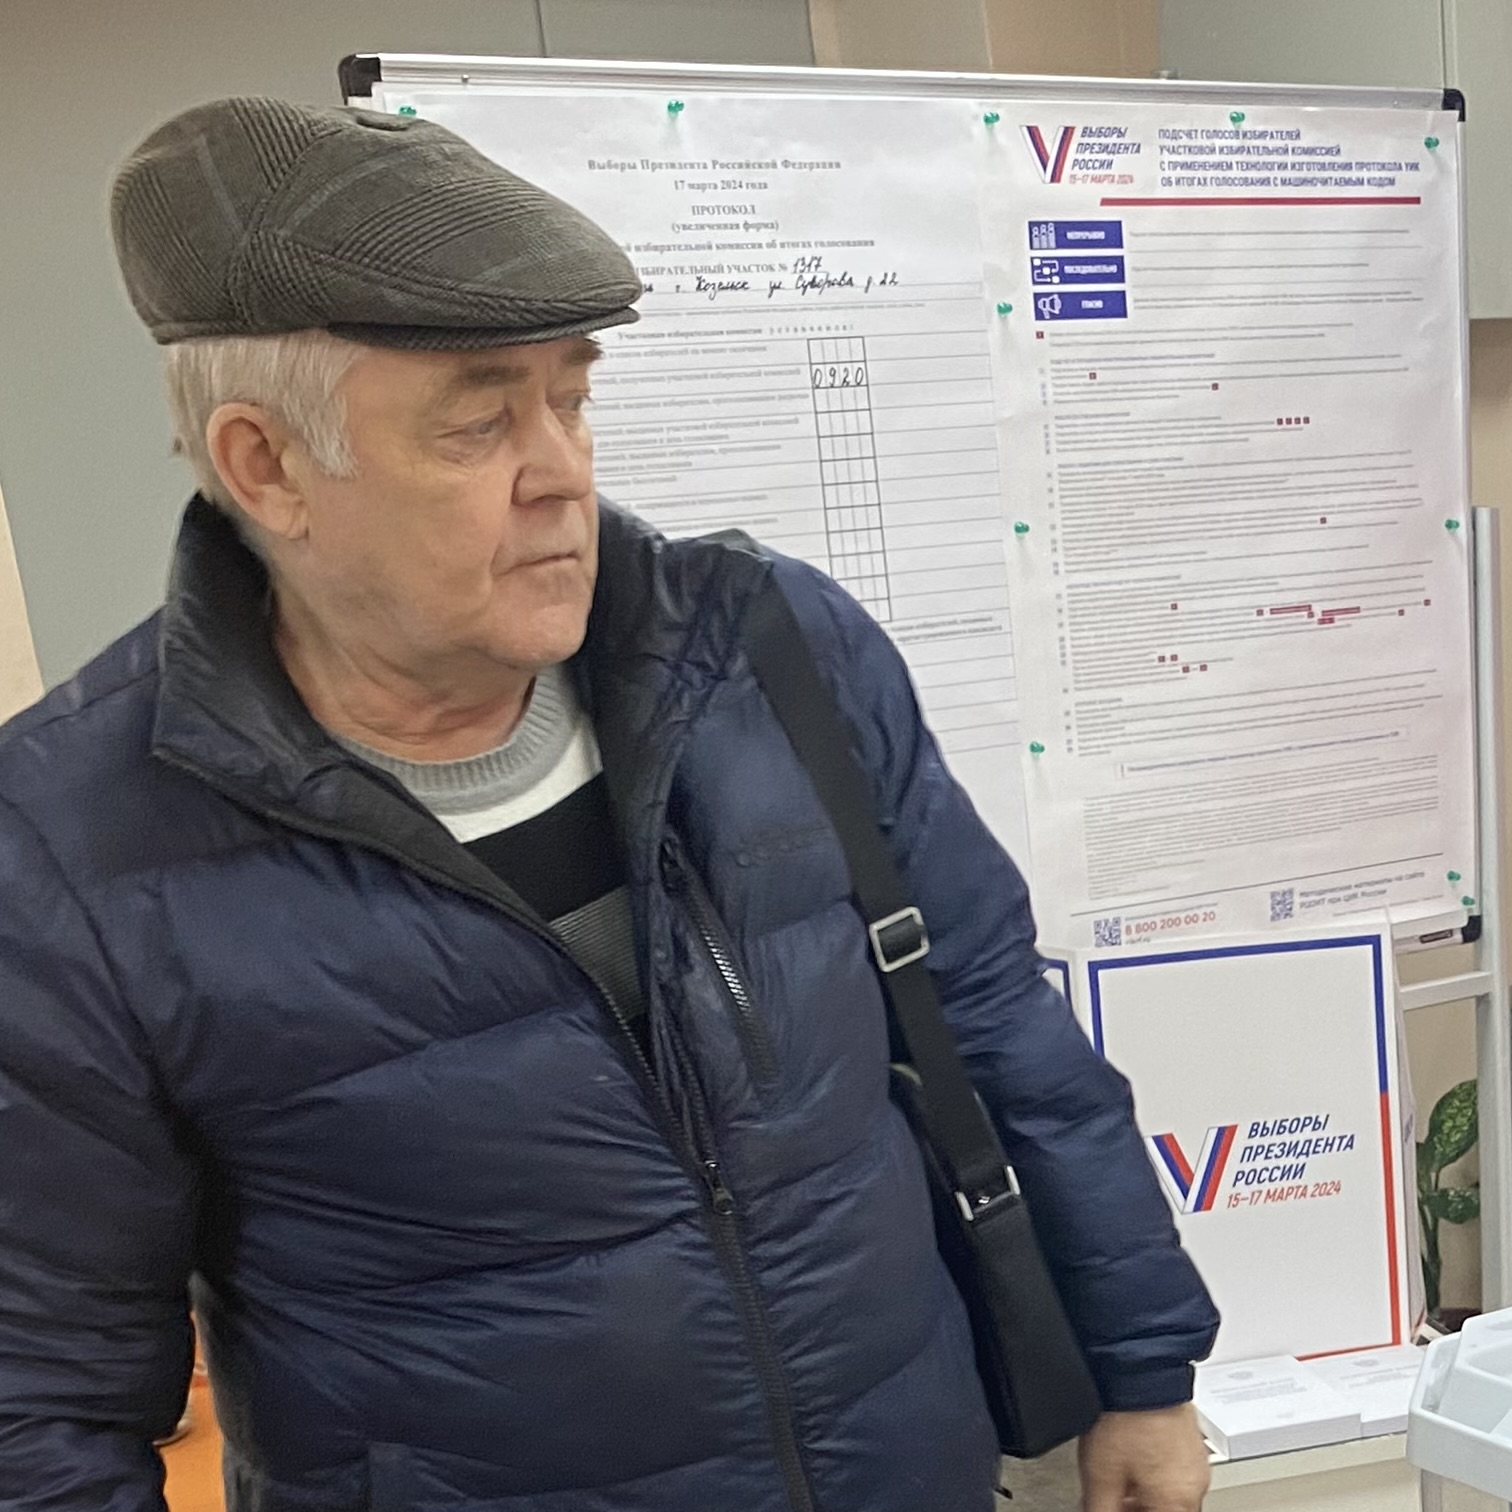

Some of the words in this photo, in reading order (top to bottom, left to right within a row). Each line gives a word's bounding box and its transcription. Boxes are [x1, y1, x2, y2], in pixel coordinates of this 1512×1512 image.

[1080, 126, 1128, 138] ВЫБОРЫ
[1158, 129, 1198, 140] ПОДСЧЕТ
[1200, 129, 1240, 139] ГОЛОСОВ
[1242, 128, 1301, 140] ИЗБИРАТЕЛЕЙ
[1075, 143, 1141, 155] ПРЕЗИДЕНТА
[1159, 144, 1216, 156] УЧАСТКОВОЙ
[1218, 144, 1289, 156] ИЗБИРАТЕЛЬНОЙ
[1291, 145, 1341, 156] КОМИССИЕЙ
[588, 159, 637, 171] Выборы
[641, 158, 708, 171] Президента
[712, 157, 778, 170] Российской
[781, 158, 842, 171] Федерации
[1071, 159, 1114, 170] РОССИИ
[1160, 162, 1165, 171] С
[1168, 162, 1233, 171] ПРИМЕНЕНИЕМ
[1236, 162, 1289, 172] ТЕХНОЛОГИИ
[1290, 162, 1353, 171] ИЗГОТОВЛЕНИЯ
[1354, 162, 1403, 171] ПРОТОКОЛА
[1090, 175, 1115, 184] МАРТА
[1161, 177, 1173, 187] ОБ
[1175, 177, 1208, 187] ИТОГАХ
[1210, 177, 1271, 187] ГОЛОСОВАНИЯ
[1280, 177, 1364, 187] МАШИНОЧИТАЕМЫМ
[1367, 177, 1395, 188] КОДОМ
[688, 181, 718, 192] марта
[721, 180, 743, 190] 2024
[692, 205, 756, 216] ПРОТОКОЛ
[727, 262, 776, 274] УЧАСТОК
[1125, 925, 1132, 936] 8
[1135, 921, 1157, 934] 800
[1160, 917, 1181, 930] 200
[1184, 913, 1200, 925] 00
[1202, 911, 1217, 922] 20
[1247, 1114, 1330, 1139] ВЫБОРЫ
[1239, 1134, 1355, 1163] ПРЕЗИДЕНТА
[1232, 1163, 1306, 1188] РОССИИ
[1264, 1184, 1308, 1205] МАРТА
[1311, 1180, 1341, 1199] 2024
